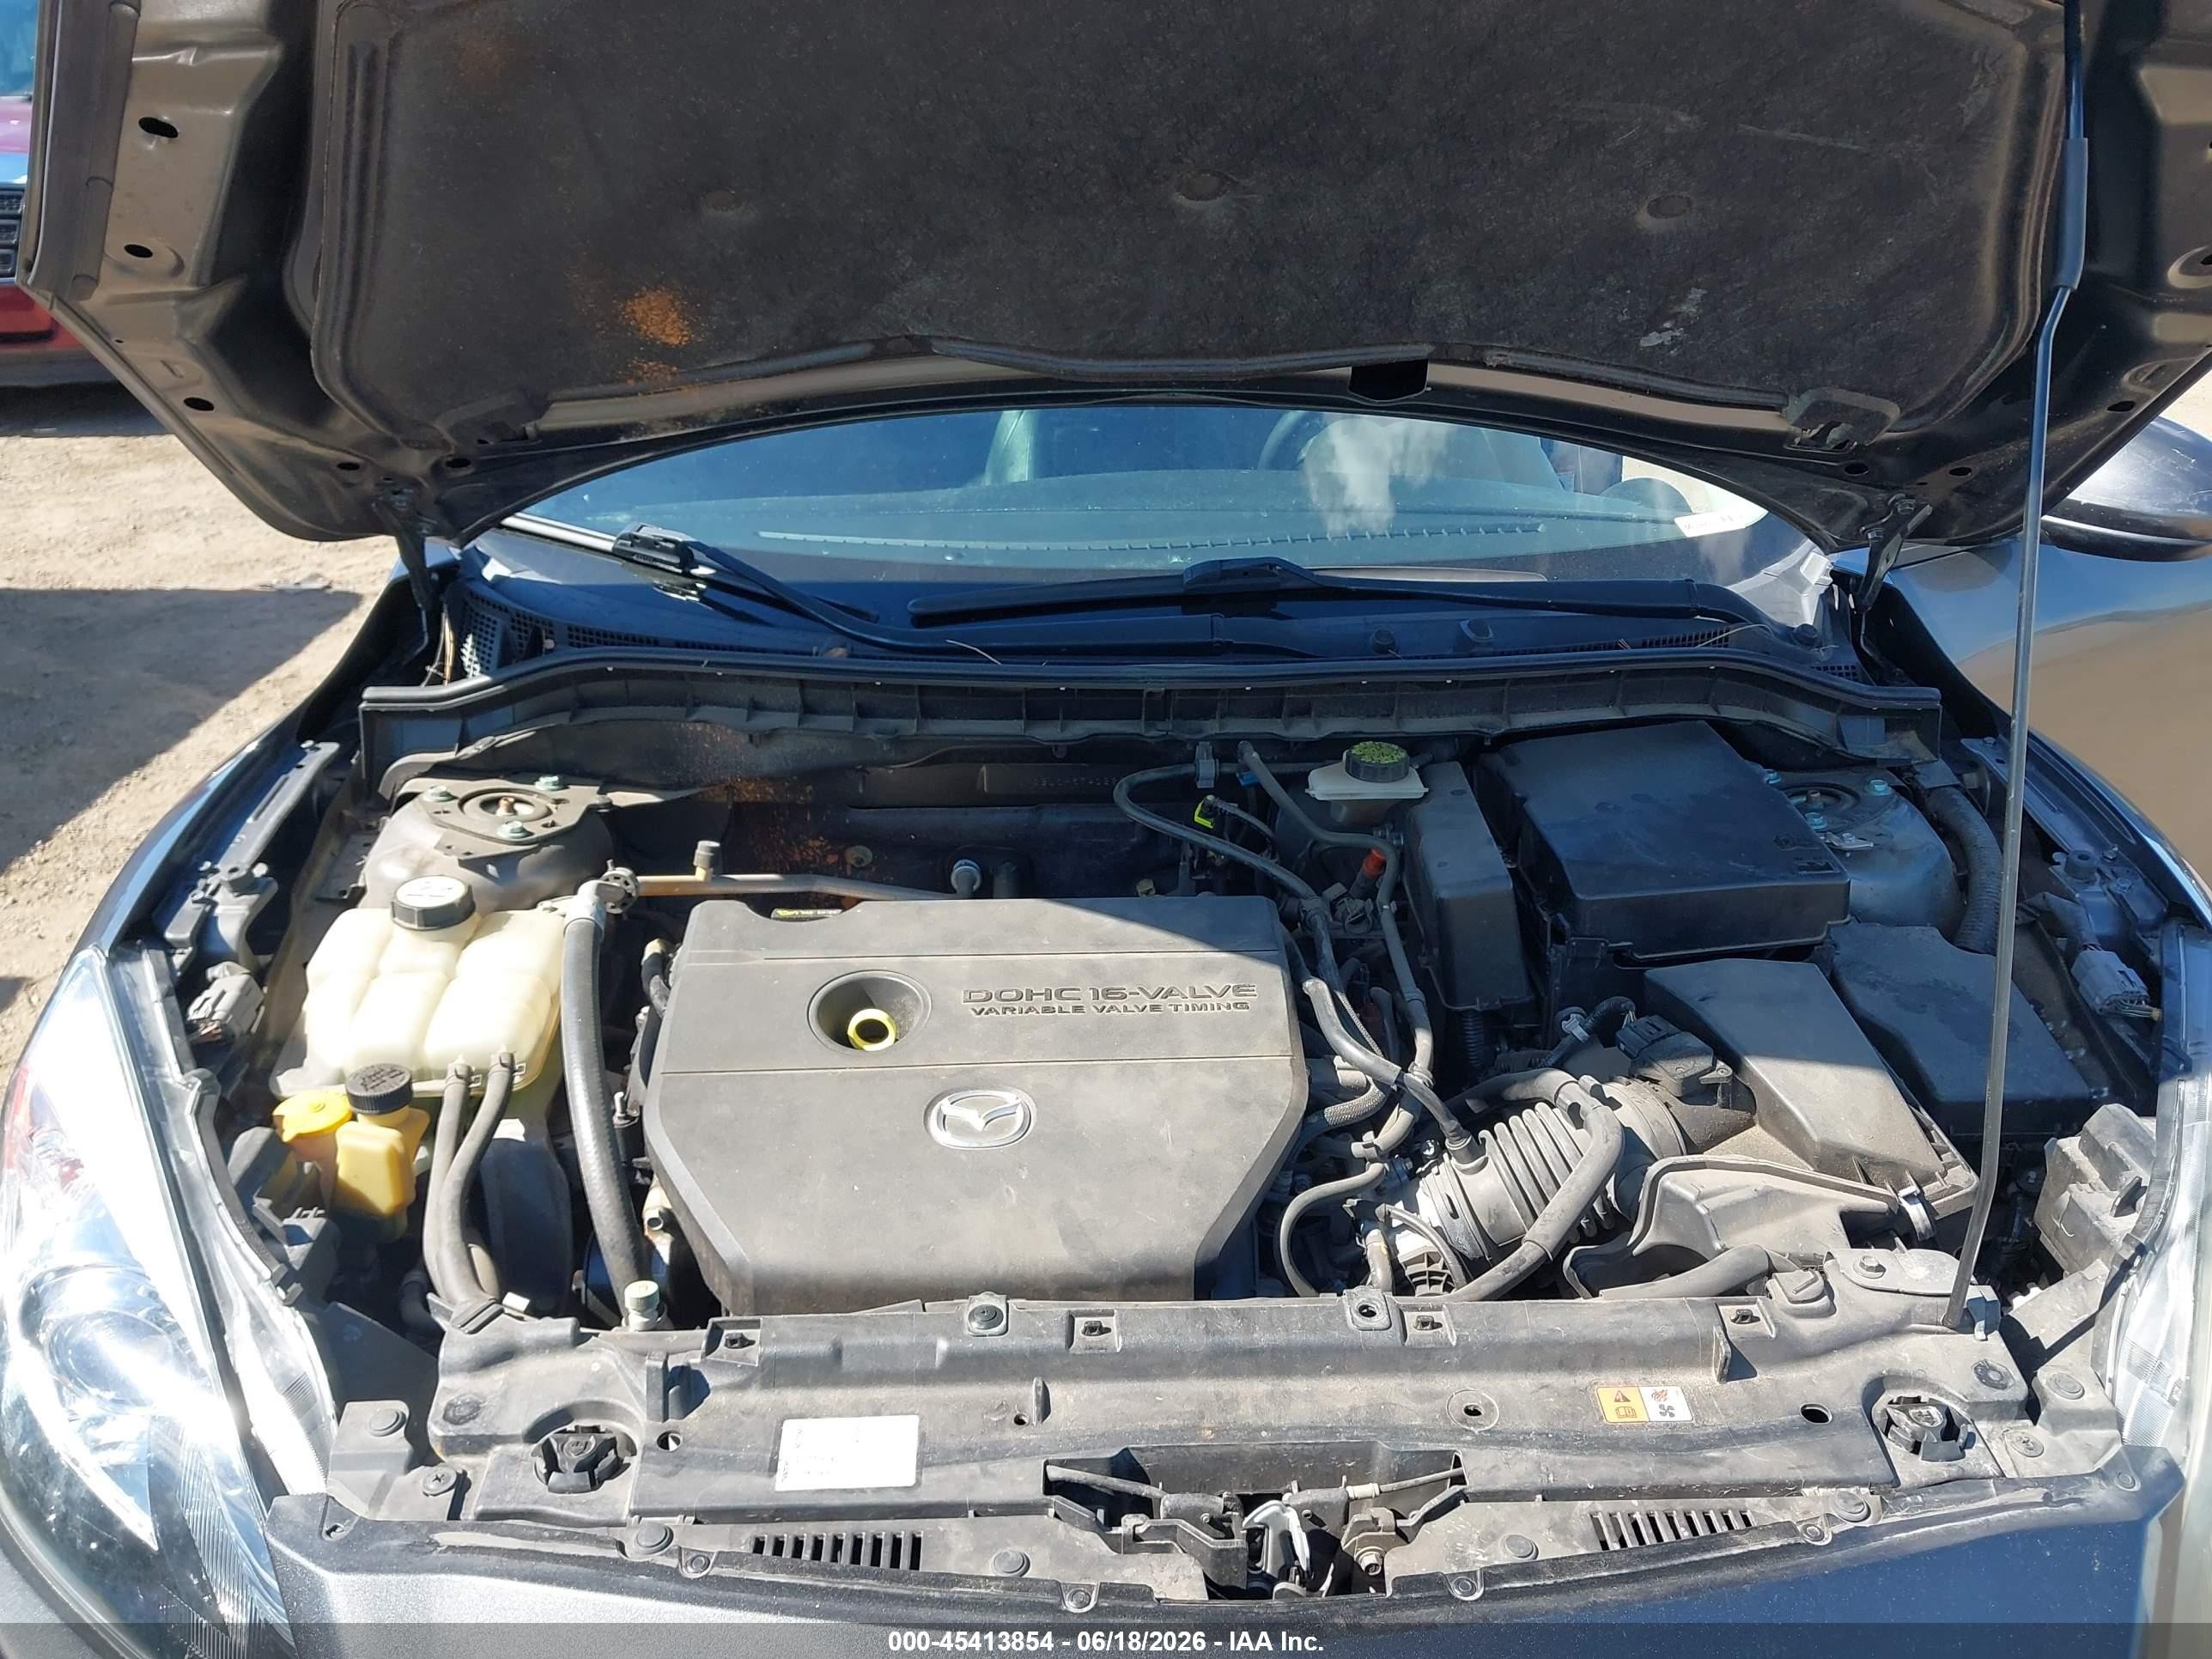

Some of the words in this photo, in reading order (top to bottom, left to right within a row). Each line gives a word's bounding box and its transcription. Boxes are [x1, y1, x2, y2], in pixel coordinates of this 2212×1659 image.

[963, 988, 1082, 1004] DOHC
[1089, 984, 1257, 1001] 16-VALVE
[970, 1005, 1086, 1017] VARIABLE
[1092, 1004, 1164, 1014] VALVE
[1168, 1001, 1250, 1012] TIMING
